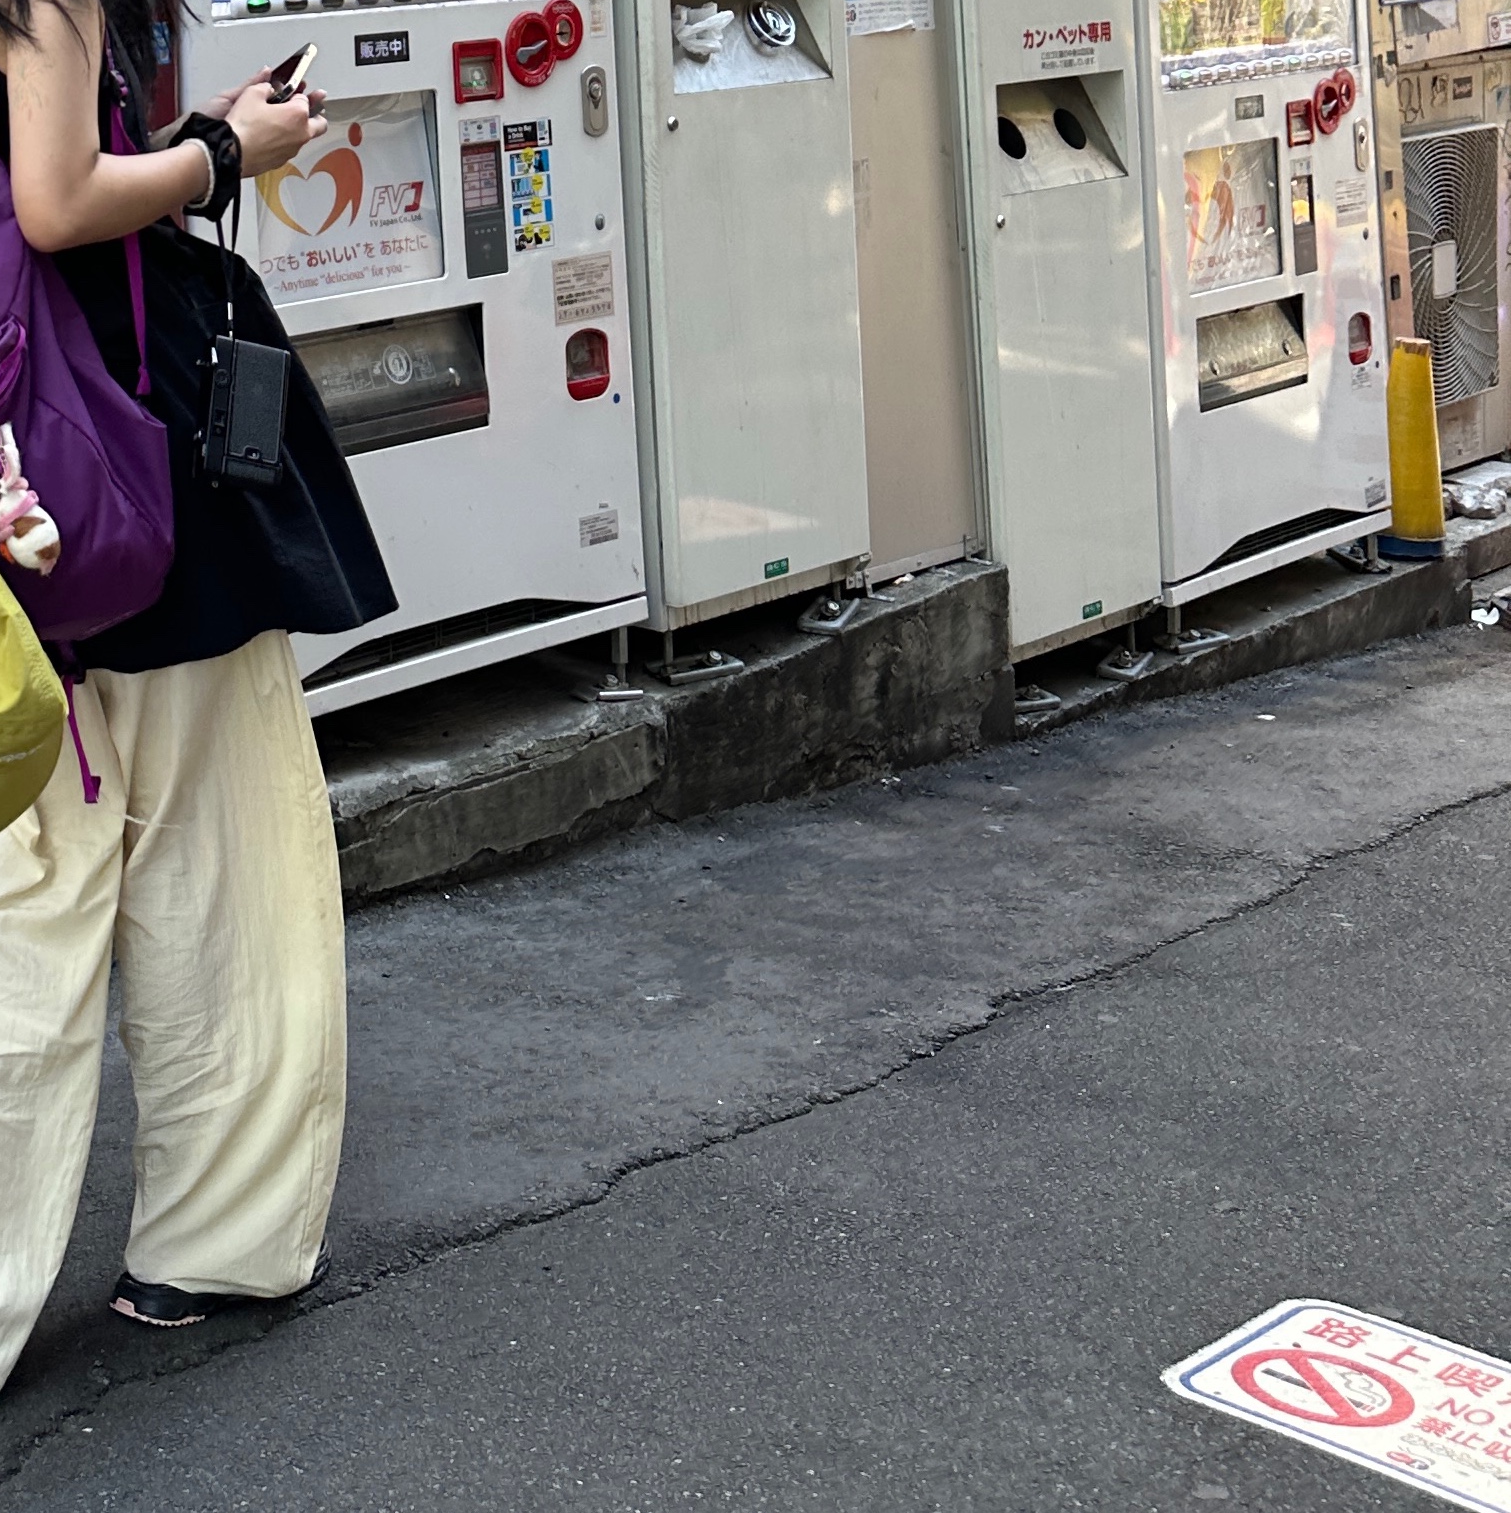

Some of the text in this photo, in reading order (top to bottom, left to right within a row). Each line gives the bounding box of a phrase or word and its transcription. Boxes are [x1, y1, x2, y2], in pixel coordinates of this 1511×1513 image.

[358, 38, 403, 60] 販売中
[1022, 21, 1112, 49] カン・ペット専用
[369, 180, 424, 218] FVJ
[1434, 1397, 1496, 1426] NO
